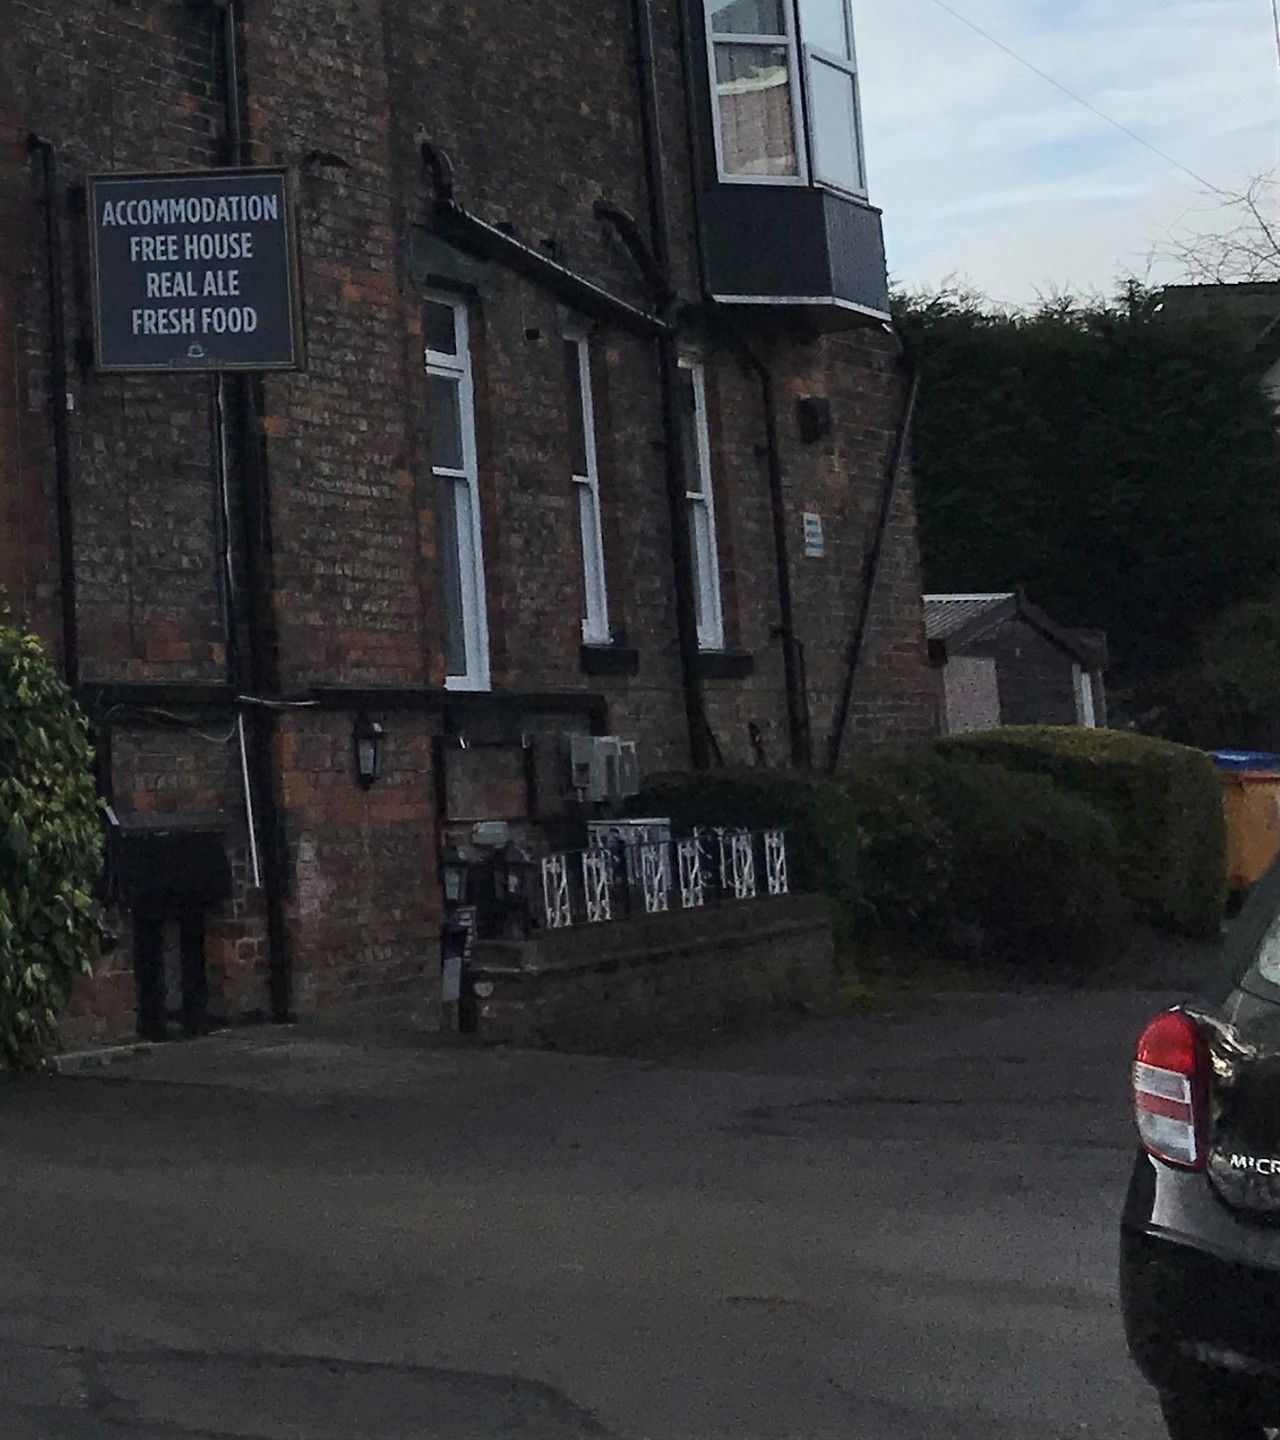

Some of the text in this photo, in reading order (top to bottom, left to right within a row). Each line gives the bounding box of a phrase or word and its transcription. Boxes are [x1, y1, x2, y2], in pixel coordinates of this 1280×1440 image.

[102, 194, 278, 226] ACCOMMODATION
[130, 232, 253, 262] FREE HOUSE
[146, 269, 240, 298] REAL ALE
[132, 306, 258, 335] FRESH FOOD
